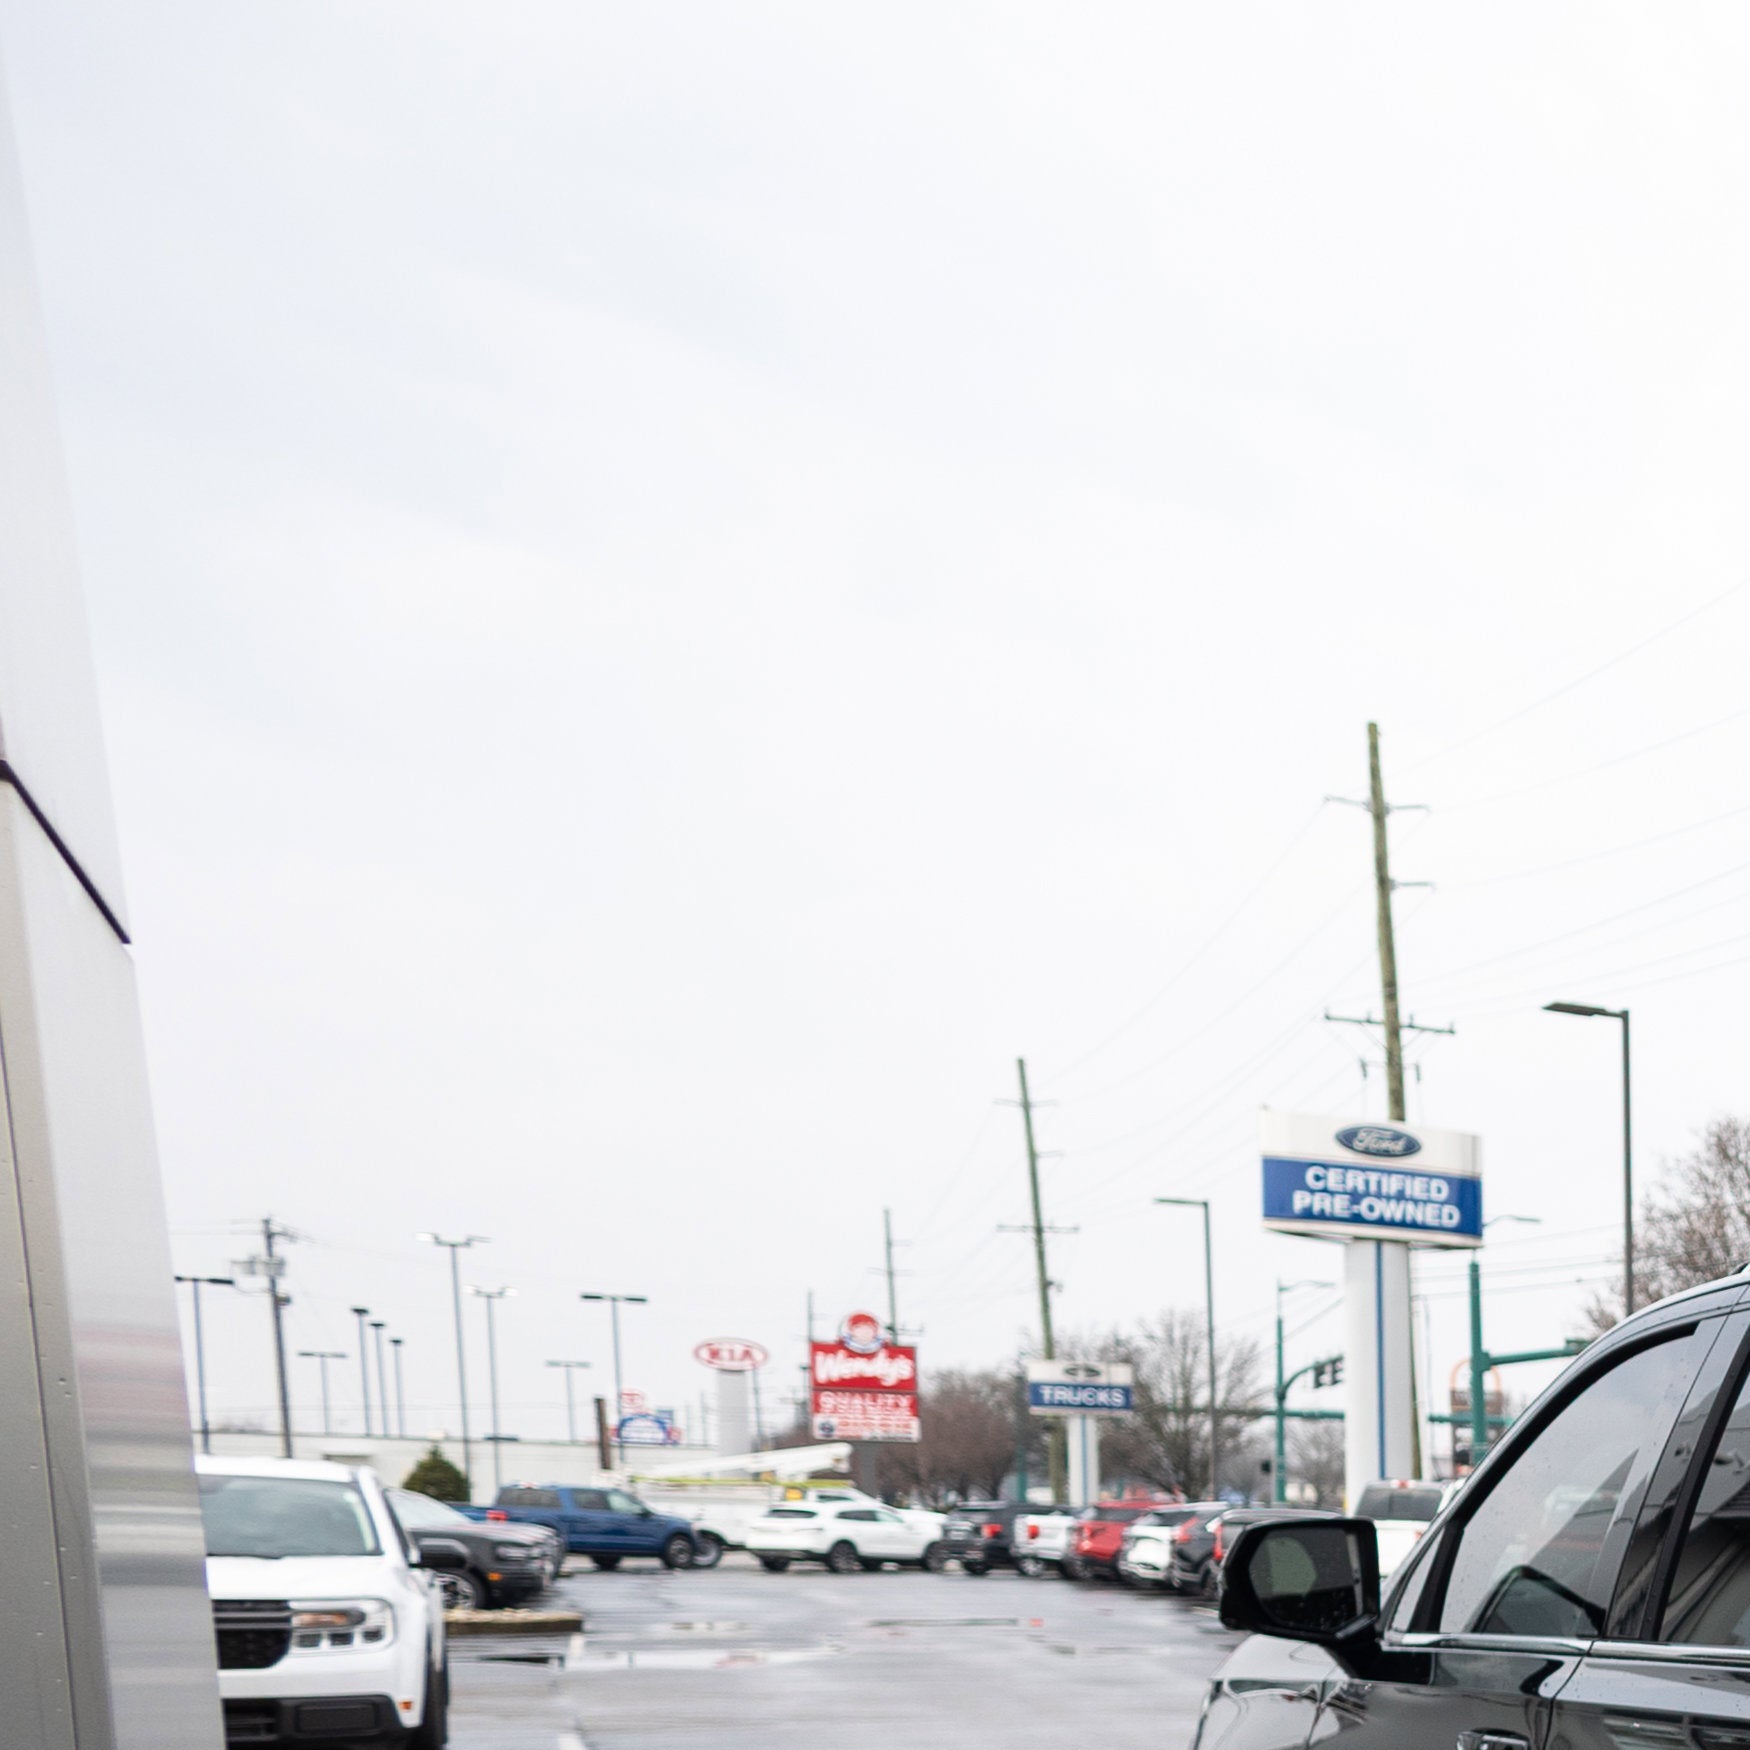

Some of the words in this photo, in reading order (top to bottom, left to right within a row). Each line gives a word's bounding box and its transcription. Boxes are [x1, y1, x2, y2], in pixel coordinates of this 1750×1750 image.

[1352, 1127, 1407, 1153] Ford
[1304, 1165, 1450, 1201] CERTIFIED
[1292, 1190, 1461, 1228] PRE-OWNED
[706, 1347, 755, 1362] KIA
[814, 1349, 915, 1387] Wendy's
[1038, 1384, 1125, 1408] TRUCKS
